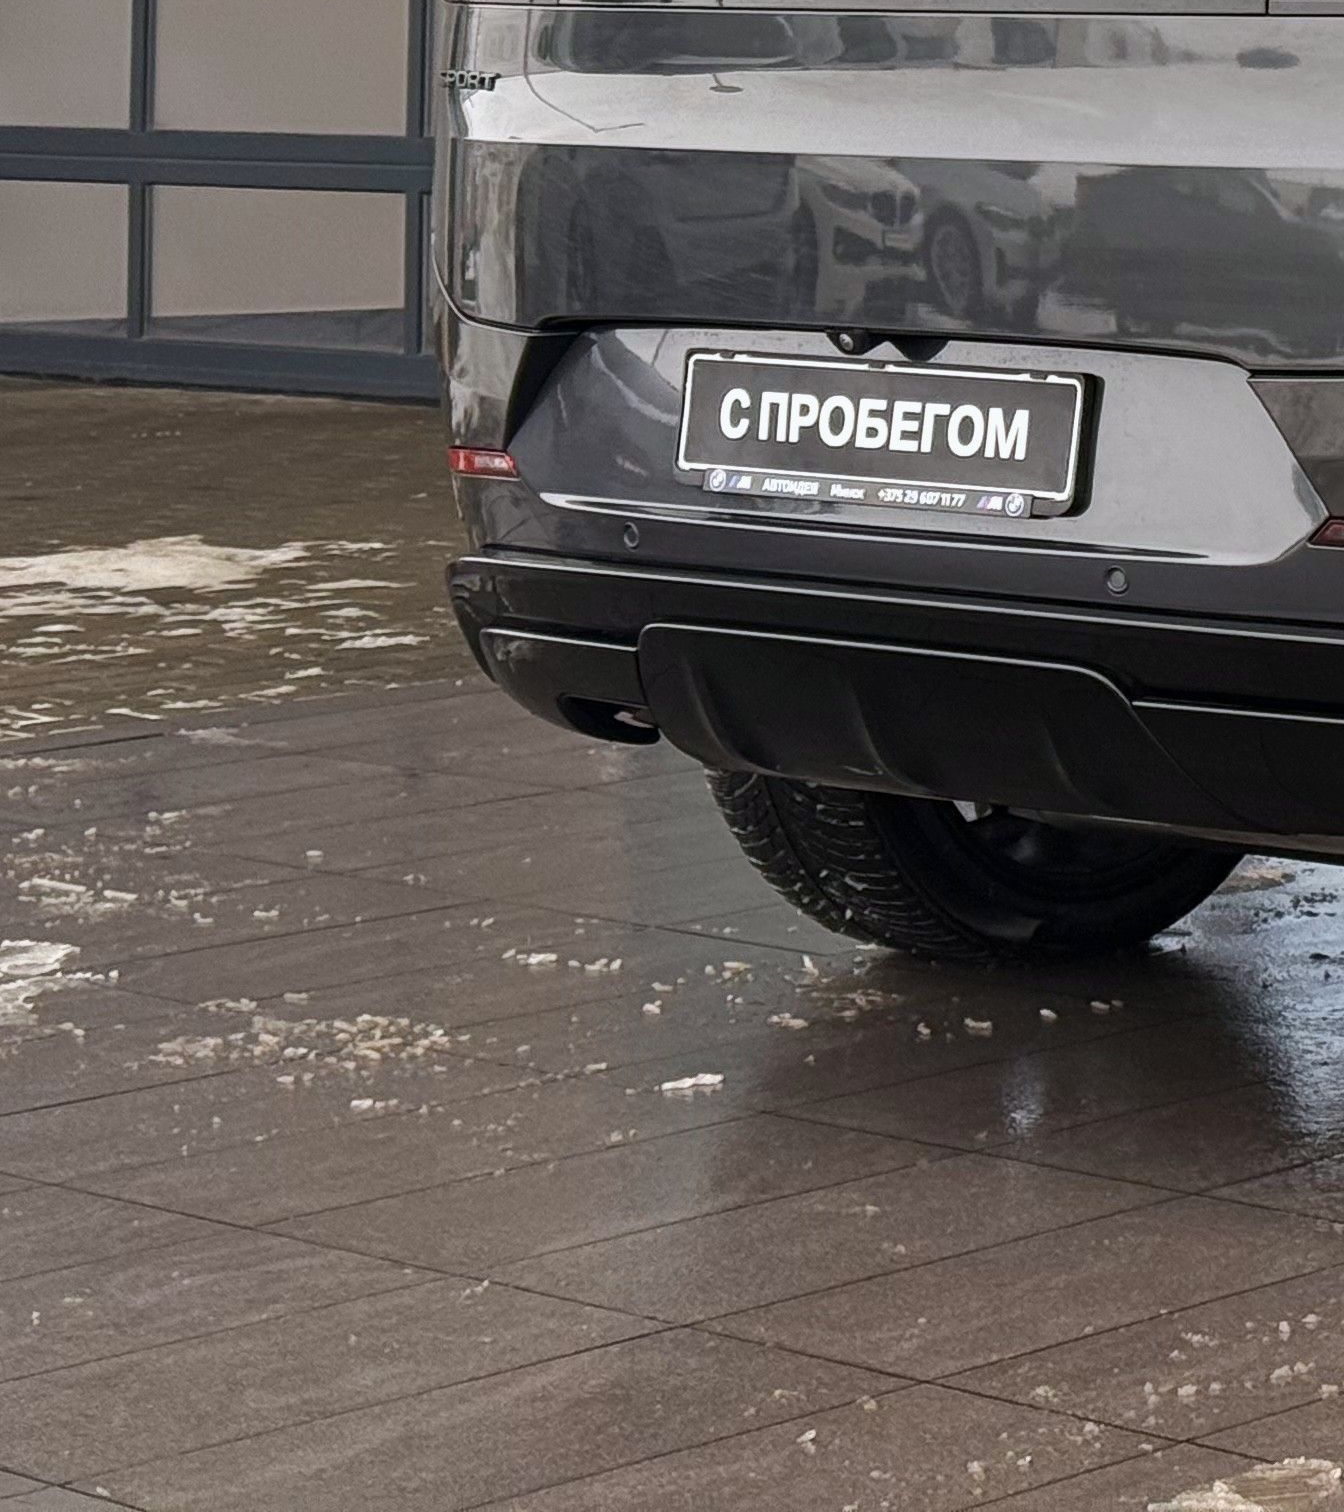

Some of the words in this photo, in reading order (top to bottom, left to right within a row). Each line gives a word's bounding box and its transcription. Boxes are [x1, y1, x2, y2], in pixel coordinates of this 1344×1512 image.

[720, 387, 751, 440] С
[758, 390, 1030, 461] ПРОБЕГОМ
[877, 487, 904, 503] +375
